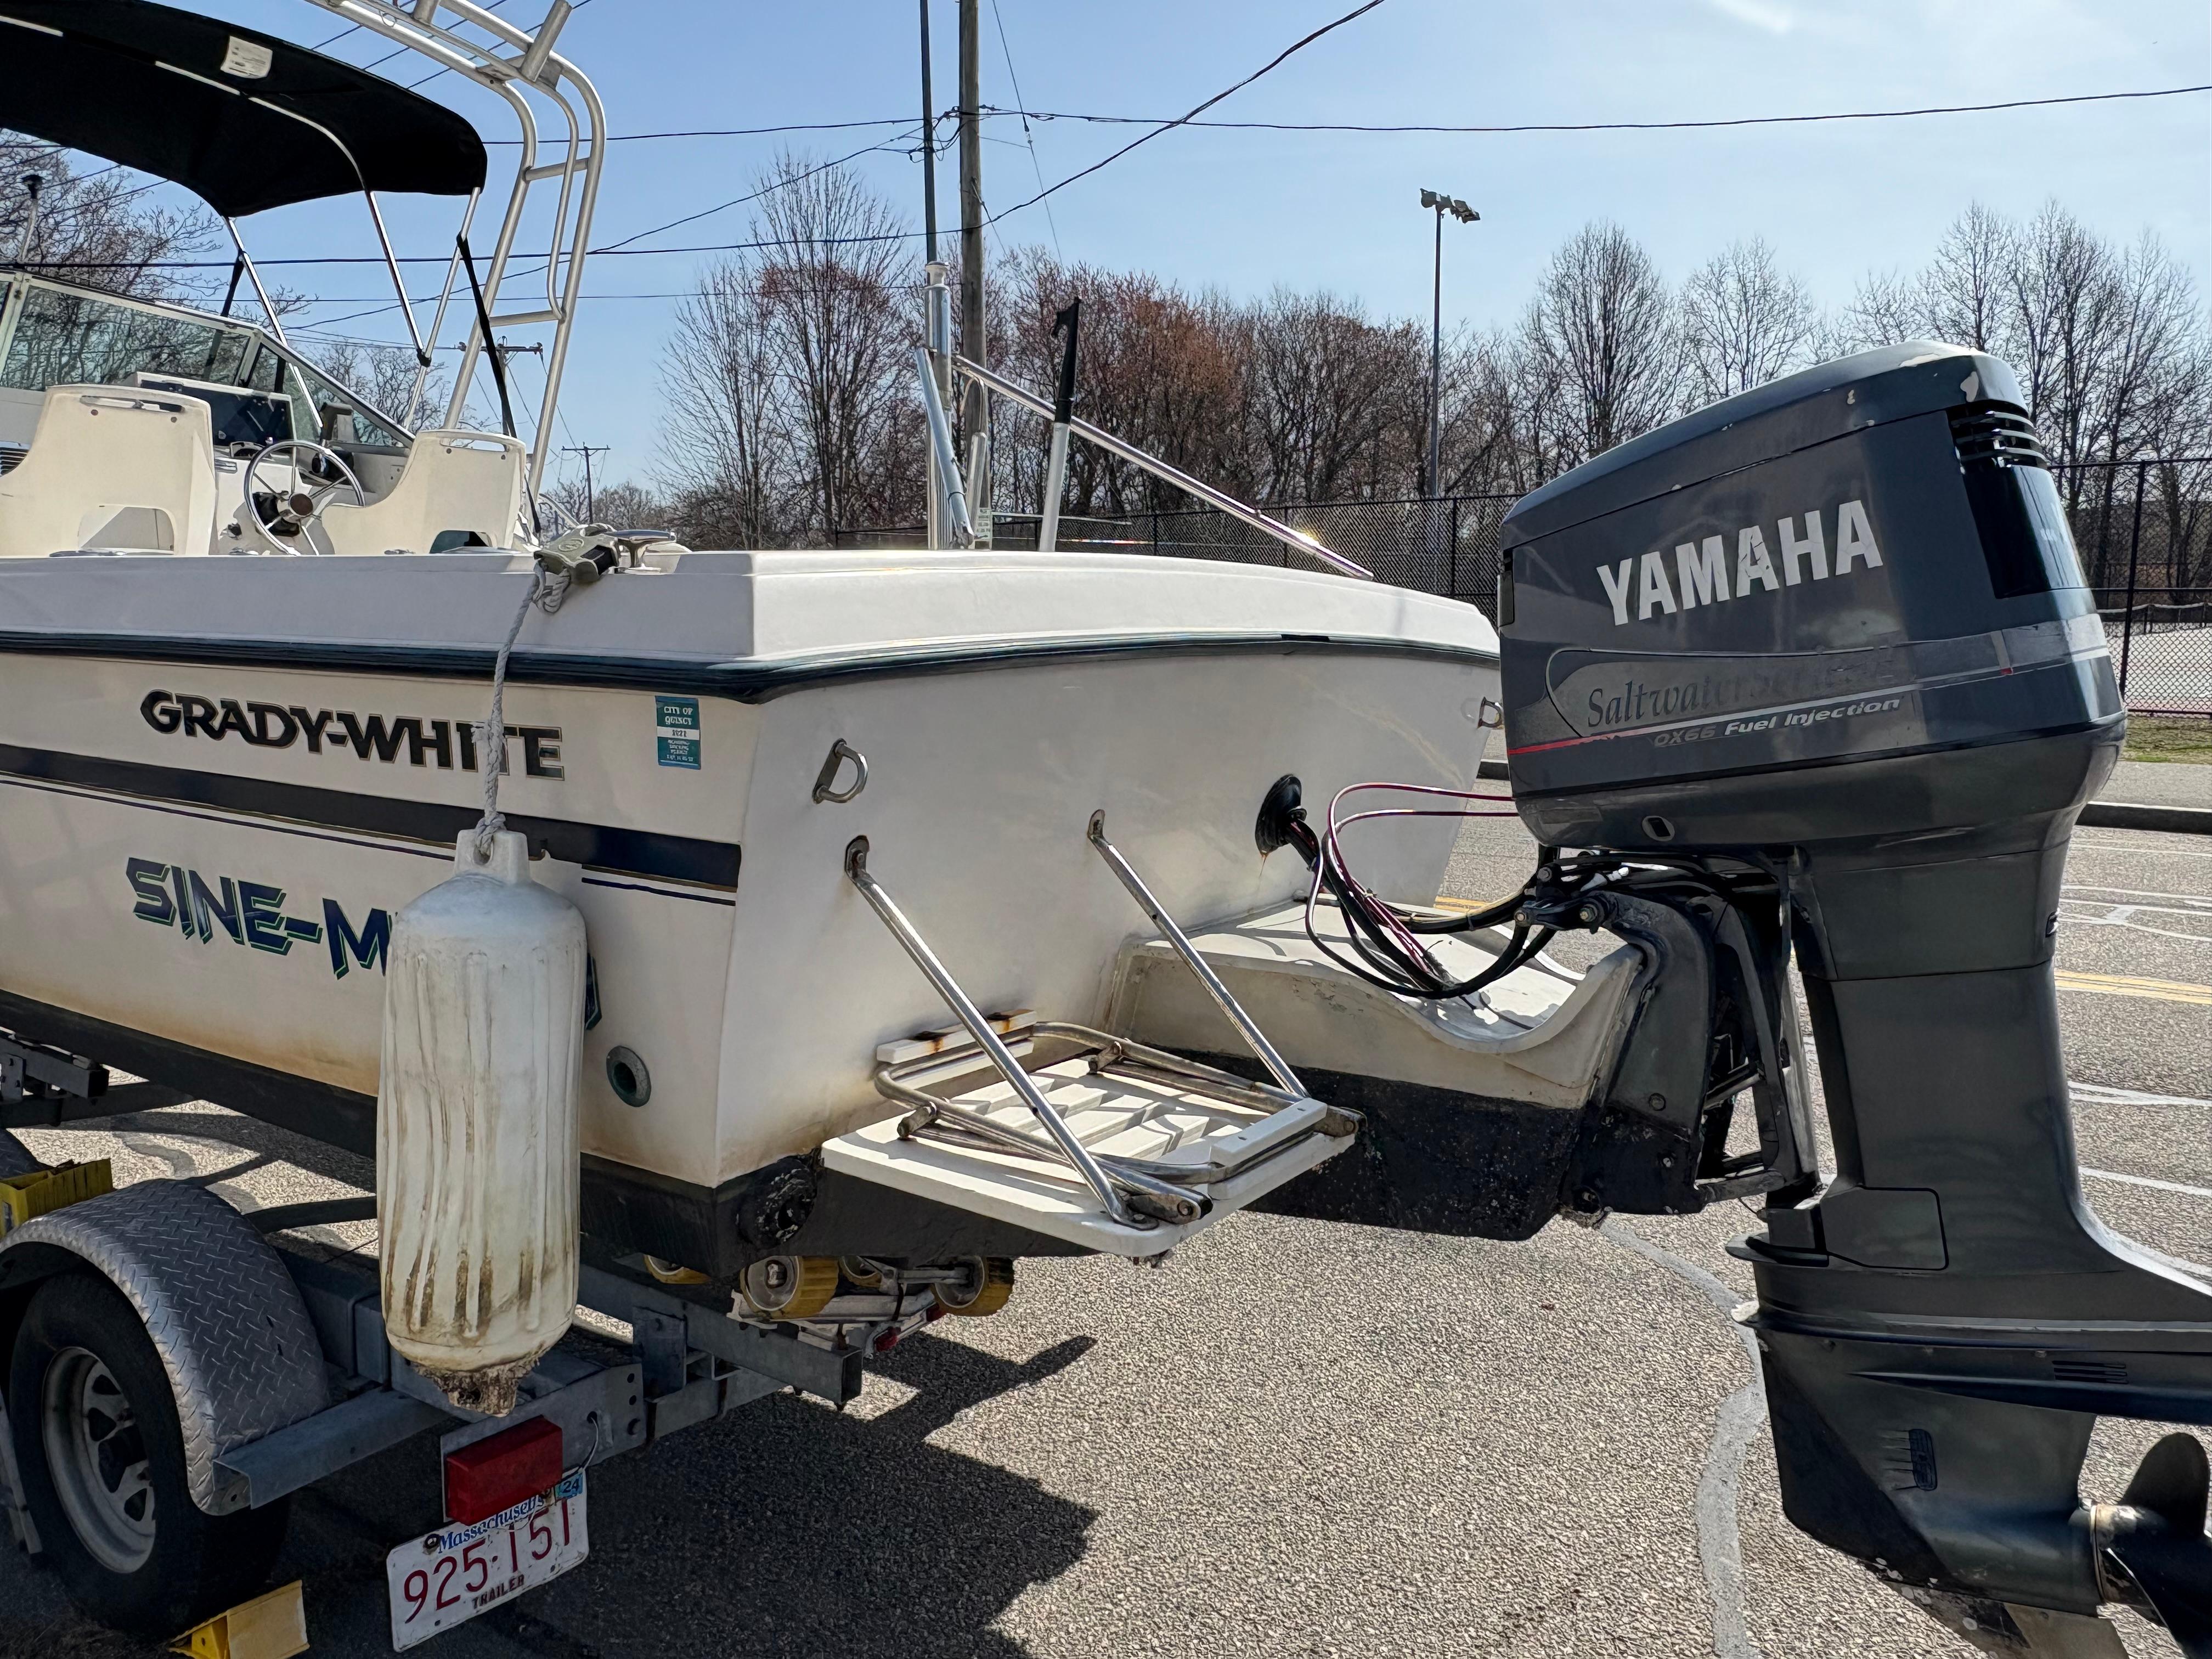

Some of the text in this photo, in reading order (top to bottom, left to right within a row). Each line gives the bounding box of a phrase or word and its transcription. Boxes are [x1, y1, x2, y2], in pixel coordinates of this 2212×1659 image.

[1596, 500, 1884, 626] YAMAHA
[140, 689, 565, 781] GRADY-WHITE
[1725, 716, 1776, 735] Fuel
[1784, 699, 1900, 726] Injection
[562, 1478, 579, 1493] 24
[438, 1494, 545, 1554] Massachusetts
[472, 1574, 525, 1609] TRAILER
